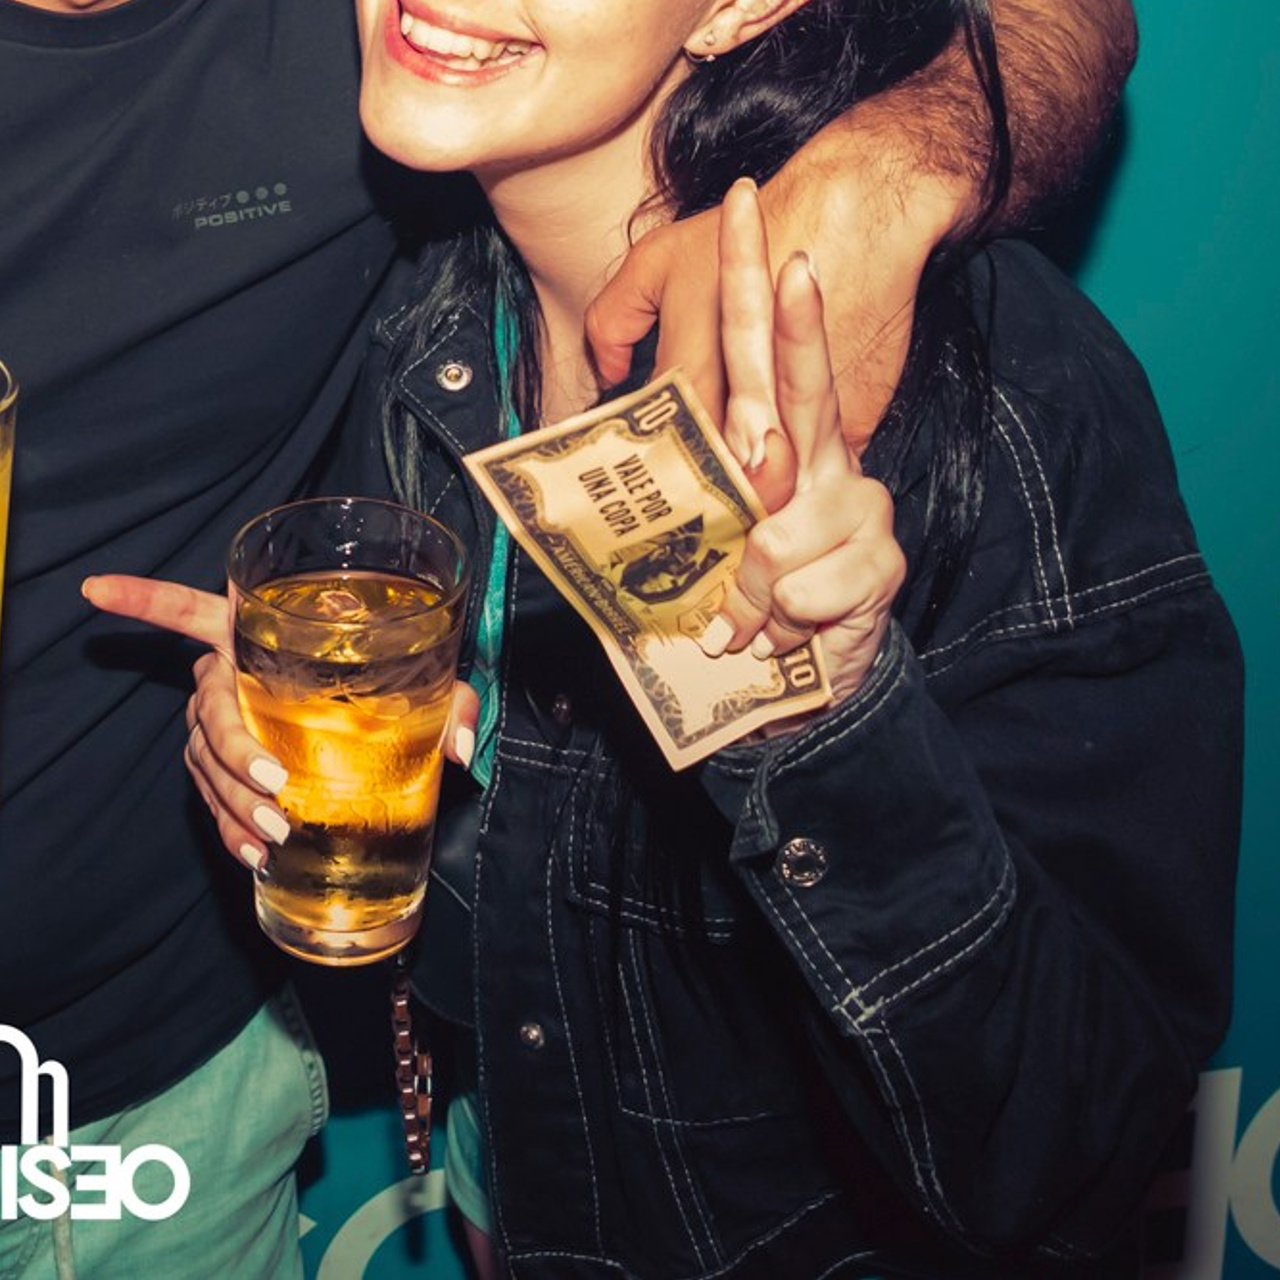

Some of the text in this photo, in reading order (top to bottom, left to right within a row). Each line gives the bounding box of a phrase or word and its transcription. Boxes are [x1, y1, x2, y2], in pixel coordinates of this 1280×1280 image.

[194, 200, 292, 229] POSITIVE
[633, 391, 678, 431] 10
[578, 466, 640, 537] UNA COPA
[613, 453, 672, 522] VALE POR
[783, 647, 816, 688] 10
